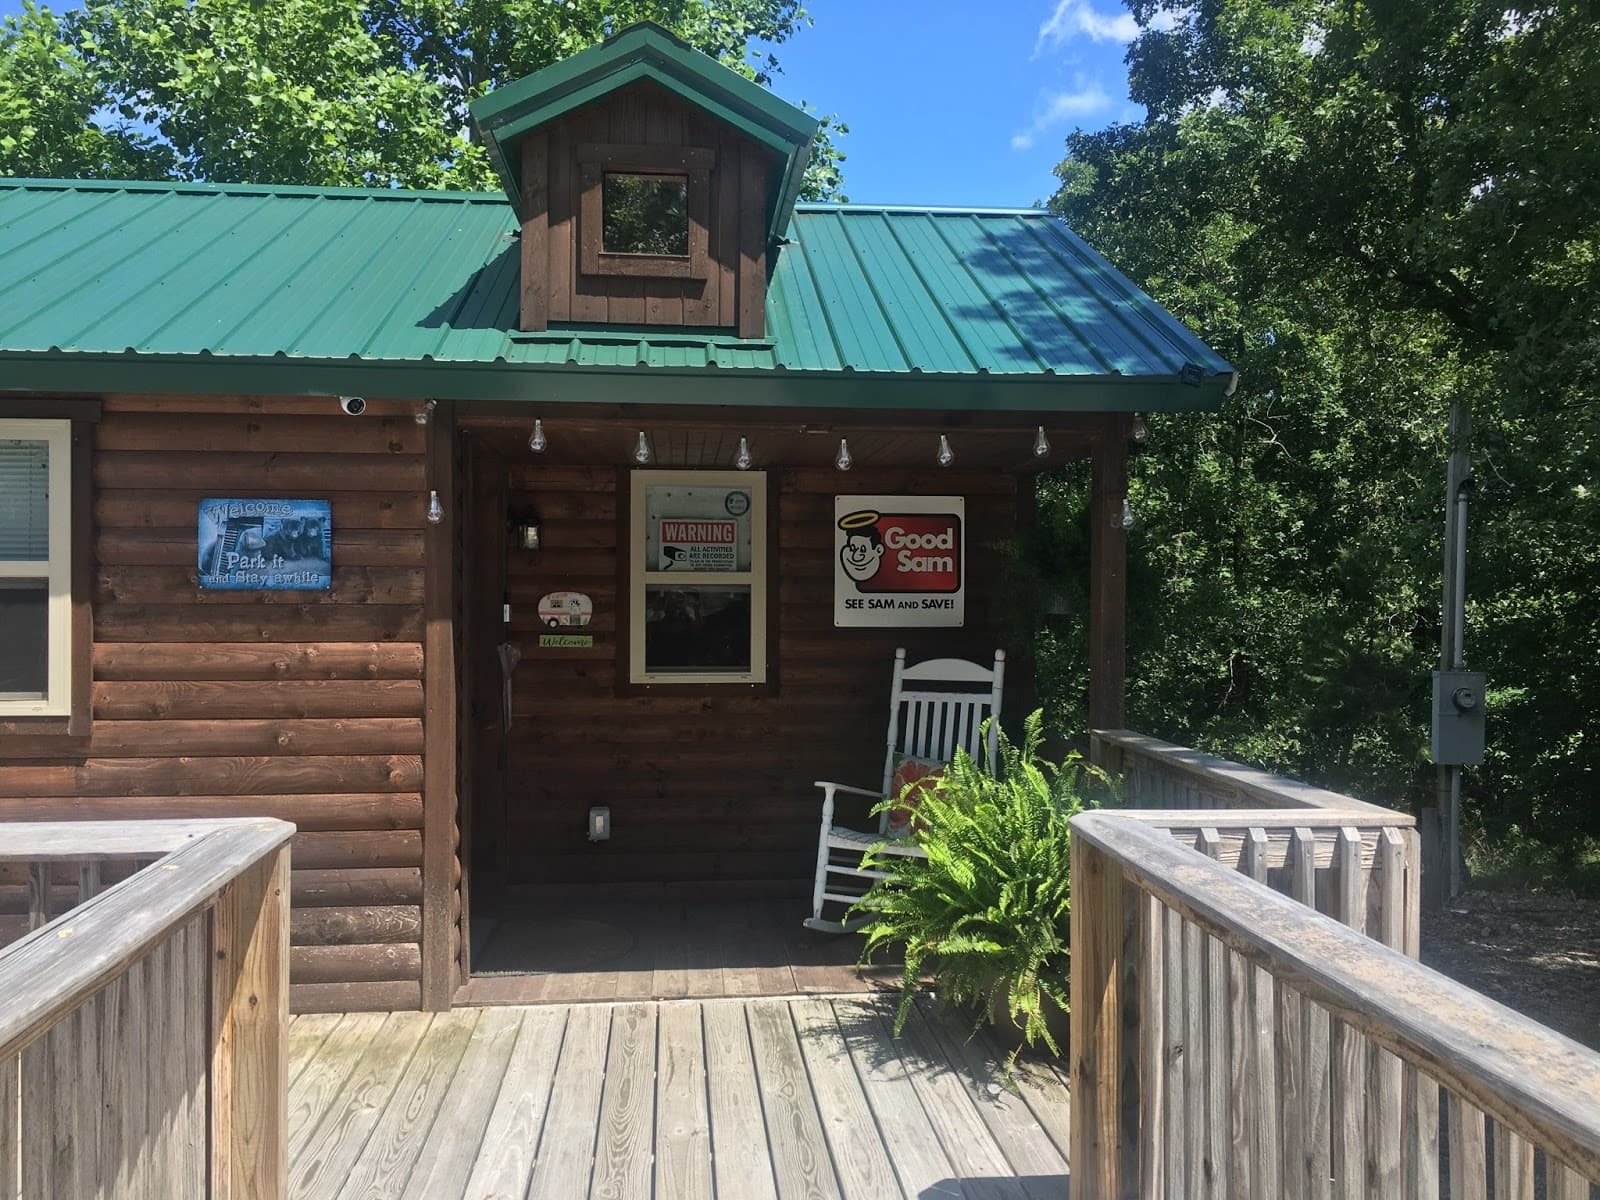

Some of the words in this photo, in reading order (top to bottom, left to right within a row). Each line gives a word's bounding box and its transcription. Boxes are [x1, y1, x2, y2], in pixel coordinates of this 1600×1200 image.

[206, 502, 294, 522] Welcome
[665, 523, 732, 541] WARNING
[885, 526, 953, 550] Good
[226, 551, 266, 570] Park
[272, 553, 285, 569] it
[897, 550, 953, 573] Sam
[208, 574, 229, 585] and
[235, 570, 268, 587] Stay
[274, 571, 320, 585] awhile
[845, 598, 864, 609] SEE
[868, 598, 895, 609] SAM
[898, 601, 919, 609] AND
[922, 598, 954, 609] SAVE!
[542, 637, 590, 646] Welcome
